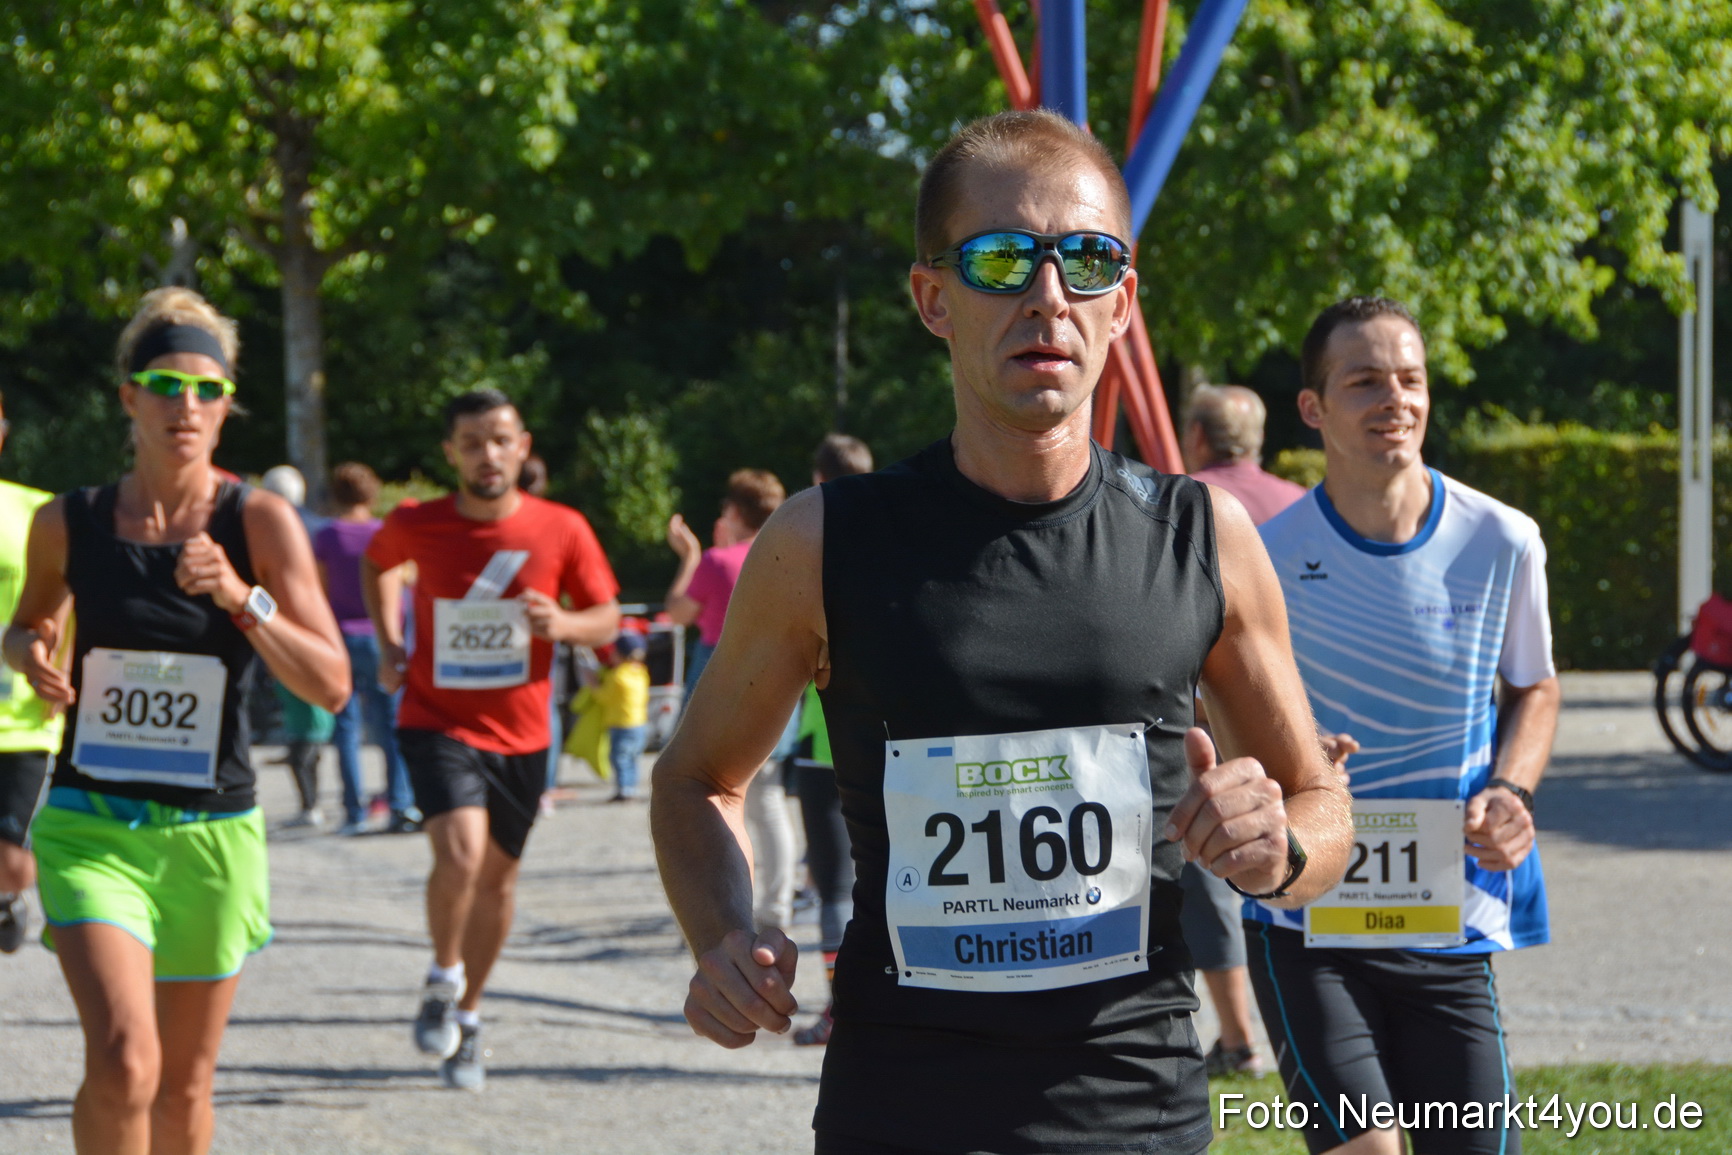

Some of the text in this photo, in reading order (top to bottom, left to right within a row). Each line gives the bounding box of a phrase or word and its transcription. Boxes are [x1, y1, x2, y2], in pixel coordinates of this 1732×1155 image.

[449, 623, 513, 650] 2622
[101, 687, 198, 731] 3032
[955, 755, 1072, 788] BOCK
[956, 783, 1074, 799] inspired by smart concepts
[924, 801, 1113, 887] 2160
[1343, 840, 1418, 884] 211
[902, 873, 913, 887] A
[943, 899, 999, 915] PARTL
[1003, 893, 1080, 912] Neumarkt
[1339, 891, 1418, 901] PARTL Neumarkt
[1365, 911, 1405, 930] Diaa
[954, 928, 1093, 965] Christian
